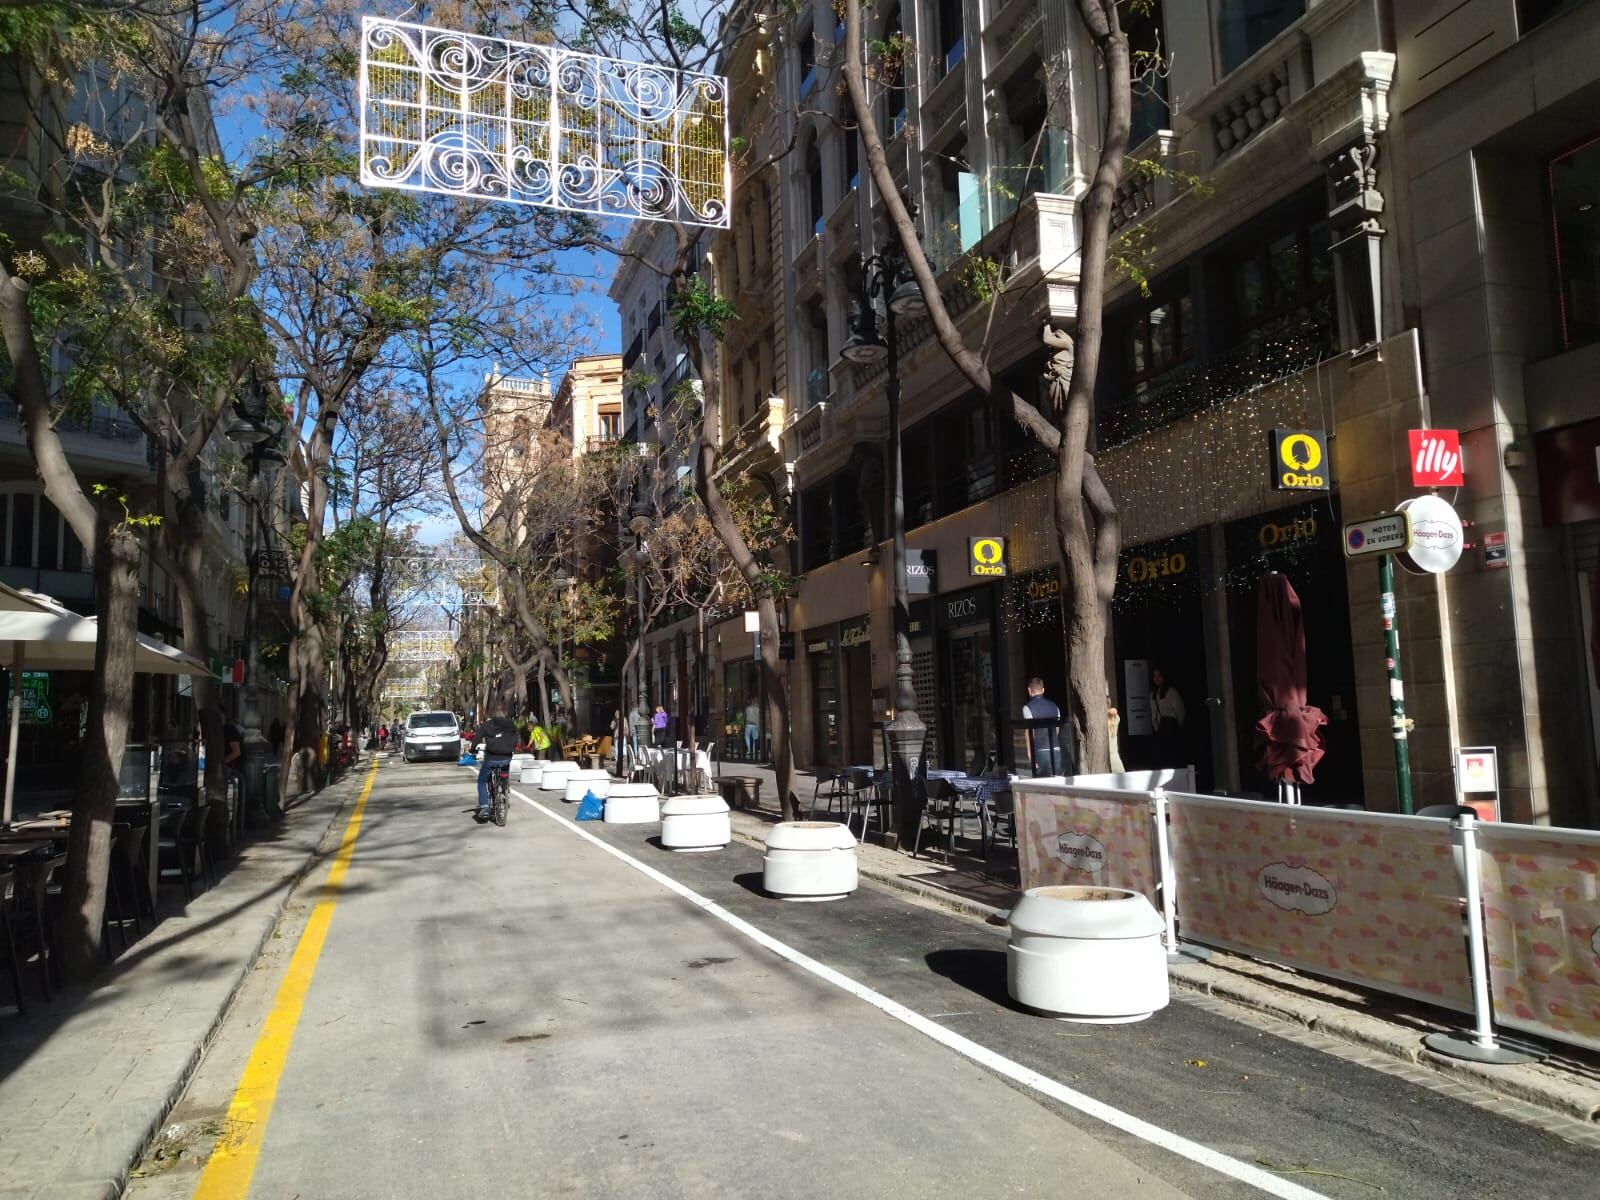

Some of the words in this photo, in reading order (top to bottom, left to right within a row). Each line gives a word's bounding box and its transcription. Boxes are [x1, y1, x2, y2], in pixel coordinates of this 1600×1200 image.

[1416, 438, 1458, 480] illy
[1282, 472, 1324, 488] Orio
[1372, 524, 1397, 534] MOTOS
[1413, 528, 1454, 541] Häagen-Dazs
[1367, 537, 1376, 545] EN
[1378, 532, 1405, 543] VORERA
[974, 565, 1003, 575] Orio
[1128, 552, 1186, 583] Orio
[948, 597, 976, 619] RIZOS
[1059, 842, 1102, 859] Häagen-Dazs
[1264, 875, 1329, 899] Häagen-Dazs
